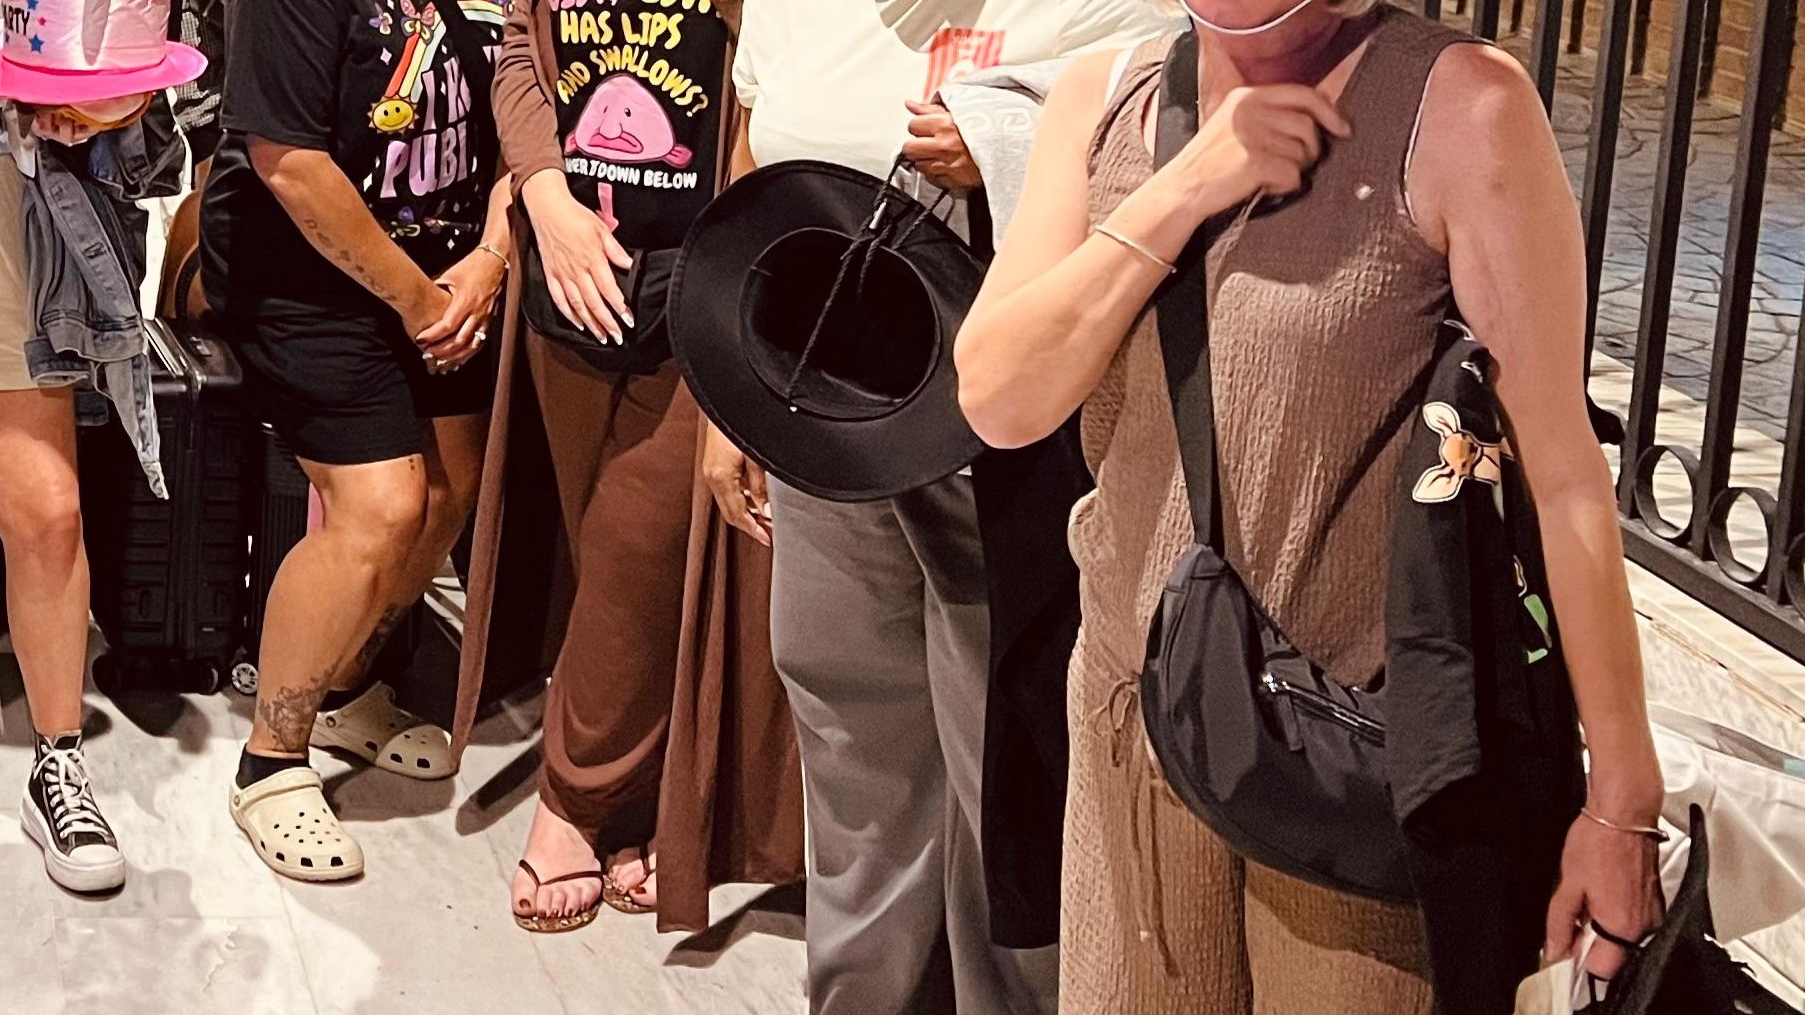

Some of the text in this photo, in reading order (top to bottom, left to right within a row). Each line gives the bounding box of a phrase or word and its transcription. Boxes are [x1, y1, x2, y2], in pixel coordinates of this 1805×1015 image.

[560, 10, 685, 51] HAS LIPS
[556, 44, 710, 118] AND SWALLOWS?
[643, 170, 698, 190] BELOW
